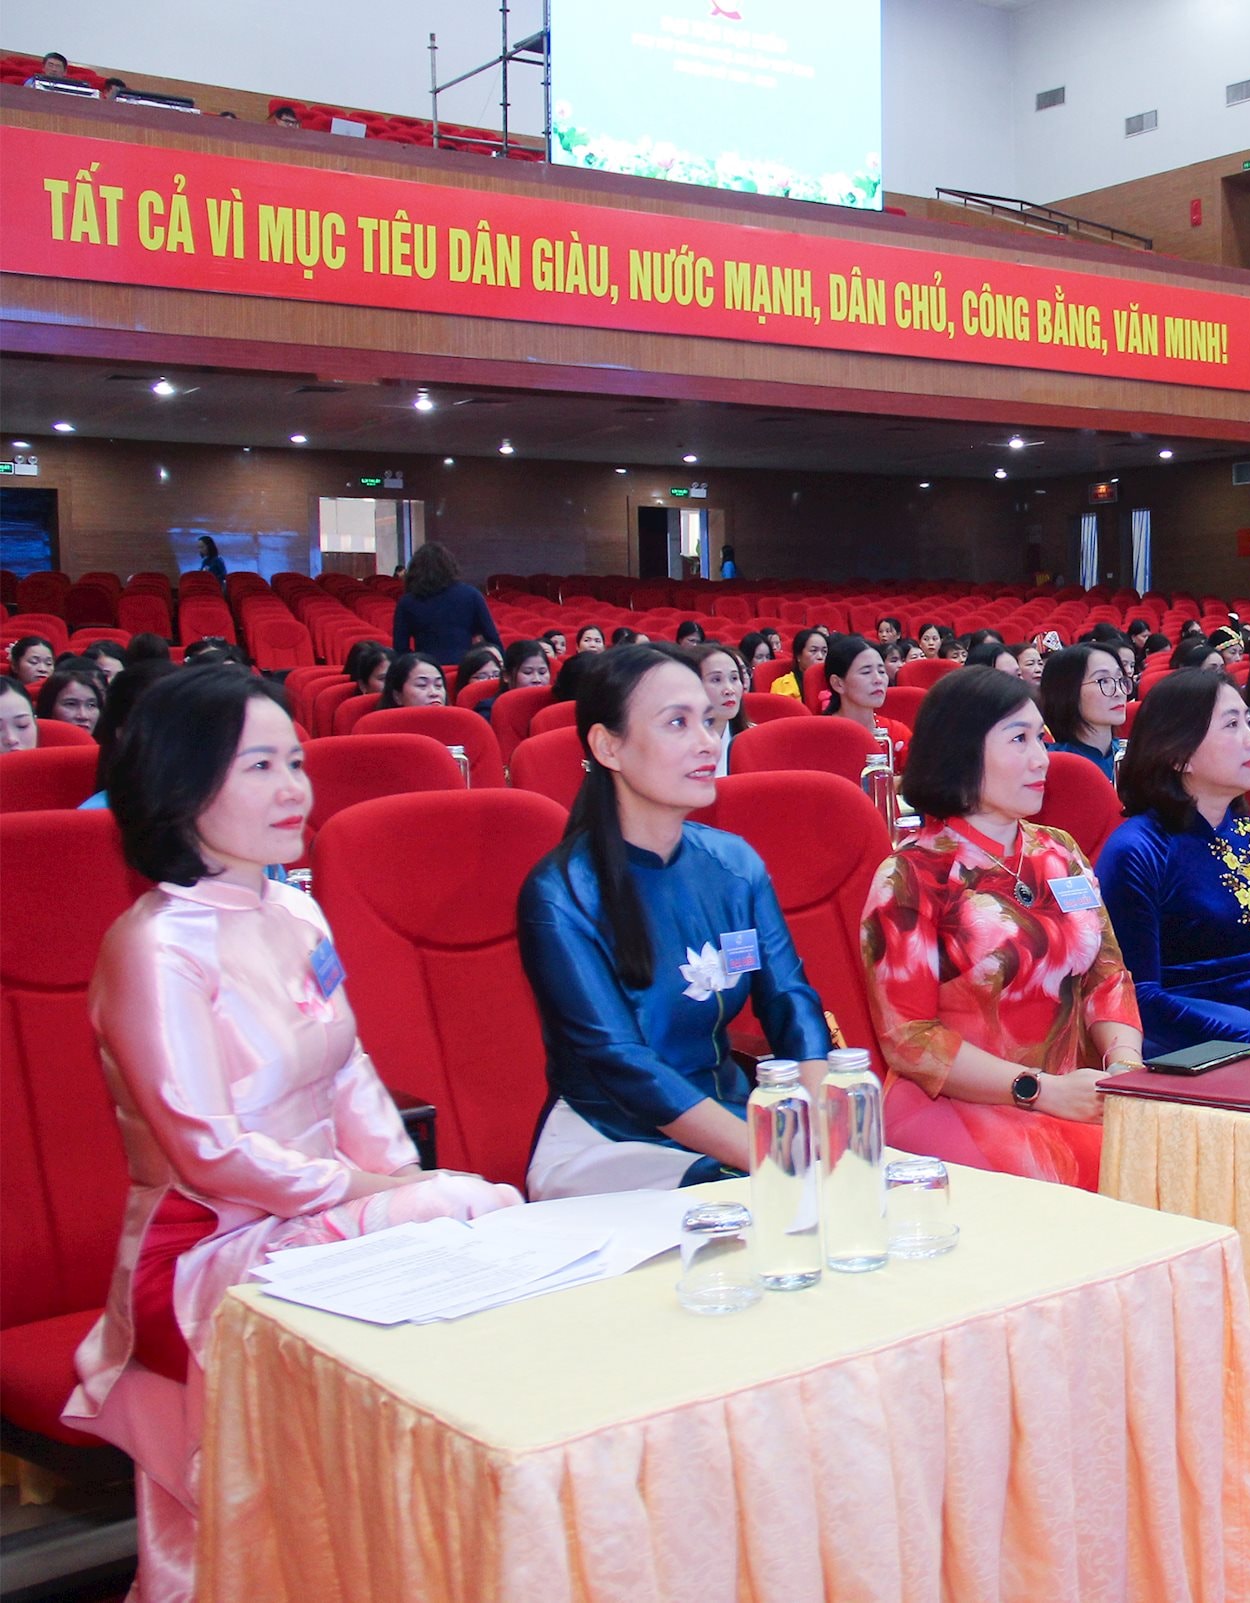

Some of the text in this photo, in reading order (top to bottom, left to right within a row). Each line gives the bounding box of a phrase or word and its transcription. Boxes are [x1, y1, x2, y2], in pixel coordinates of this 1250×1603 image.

[43, 161, 1228, 365] TẤT CẢ VÌ MỤC TIÊU DÂN GIÀU, NƯỚC MẠNH, DÂN CHỦ, CÔNG BẰNG, VĂN MINH!
